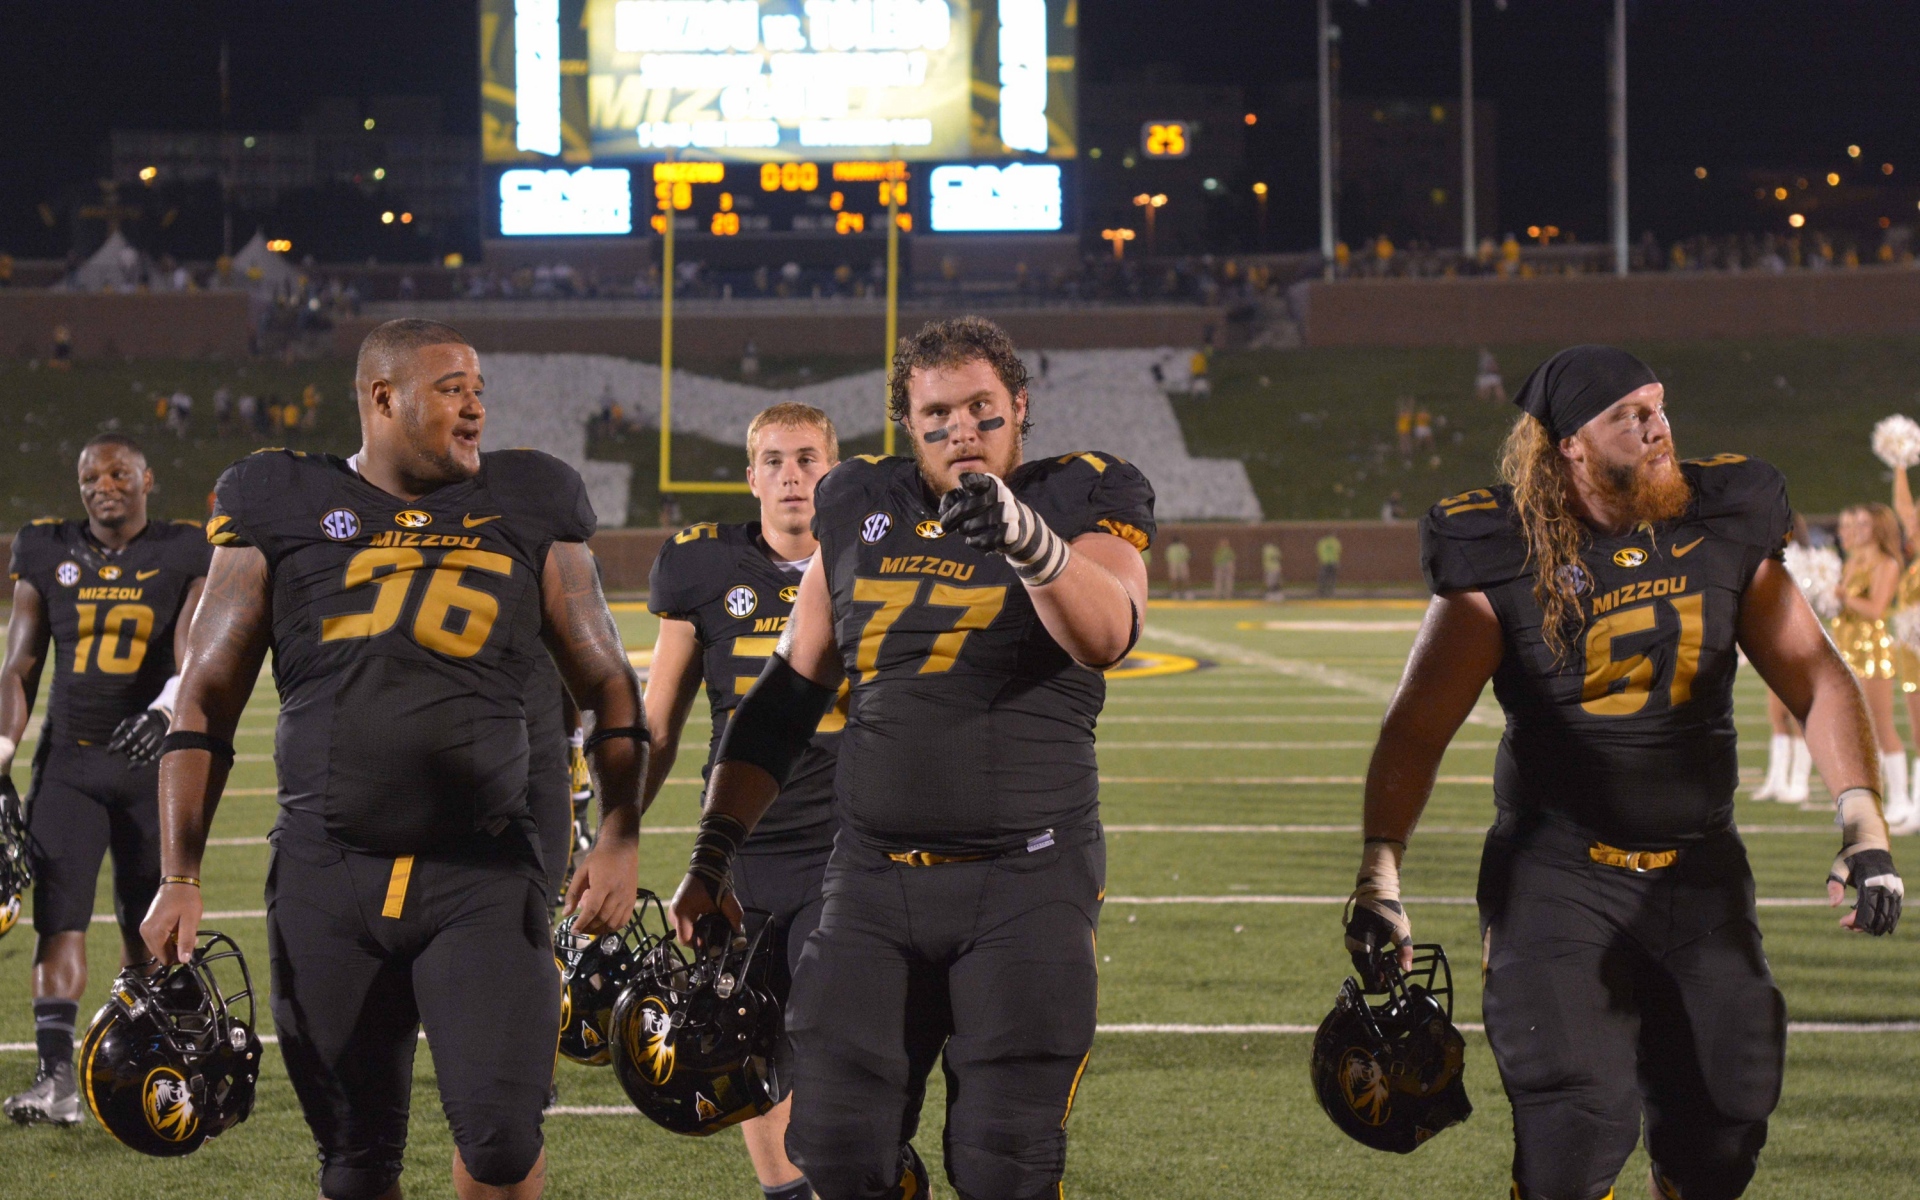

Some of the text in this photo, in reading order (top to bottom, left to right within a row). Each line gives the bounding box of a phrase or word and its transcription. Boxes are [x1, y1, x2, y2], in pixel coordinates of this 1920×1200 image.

[323, 511, 357, 539] SEC
[368, 530, 481, 549] MIZZOU
[861, 513, 890, 542] SEC
[57, 562, 80, 585] SEC
[879, 555, 975, 581] MIZZOU
[78, 587, 143, 600] MIZZOU
[726, 587, 756, 617] SEC
[1592, 576, 1687, 615] MIZZOU
[72, 603, 155, 675] 10
[853, 577, 1007, 683] 77
[1580, 593, 1704, 716] 61
